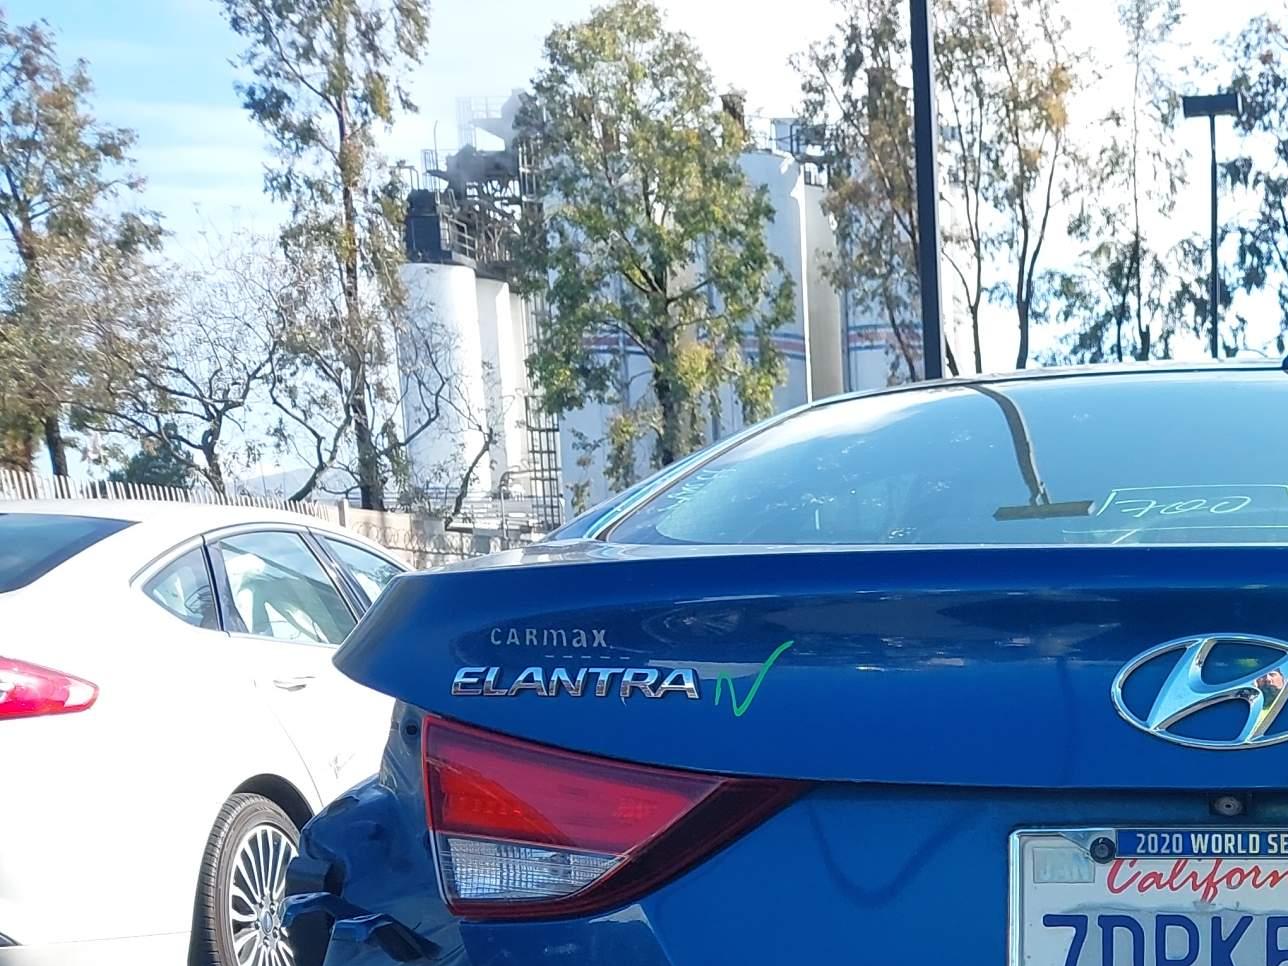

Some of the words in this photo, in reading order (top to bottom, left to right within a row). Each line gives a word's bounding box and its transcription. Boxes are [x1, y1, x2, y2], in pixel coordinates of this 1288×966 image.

[450, 666, 700, 698] ELANTRA
[1136, 832, 1183, 854] 2020
[1190, 833, 1261, 854] WORLD
